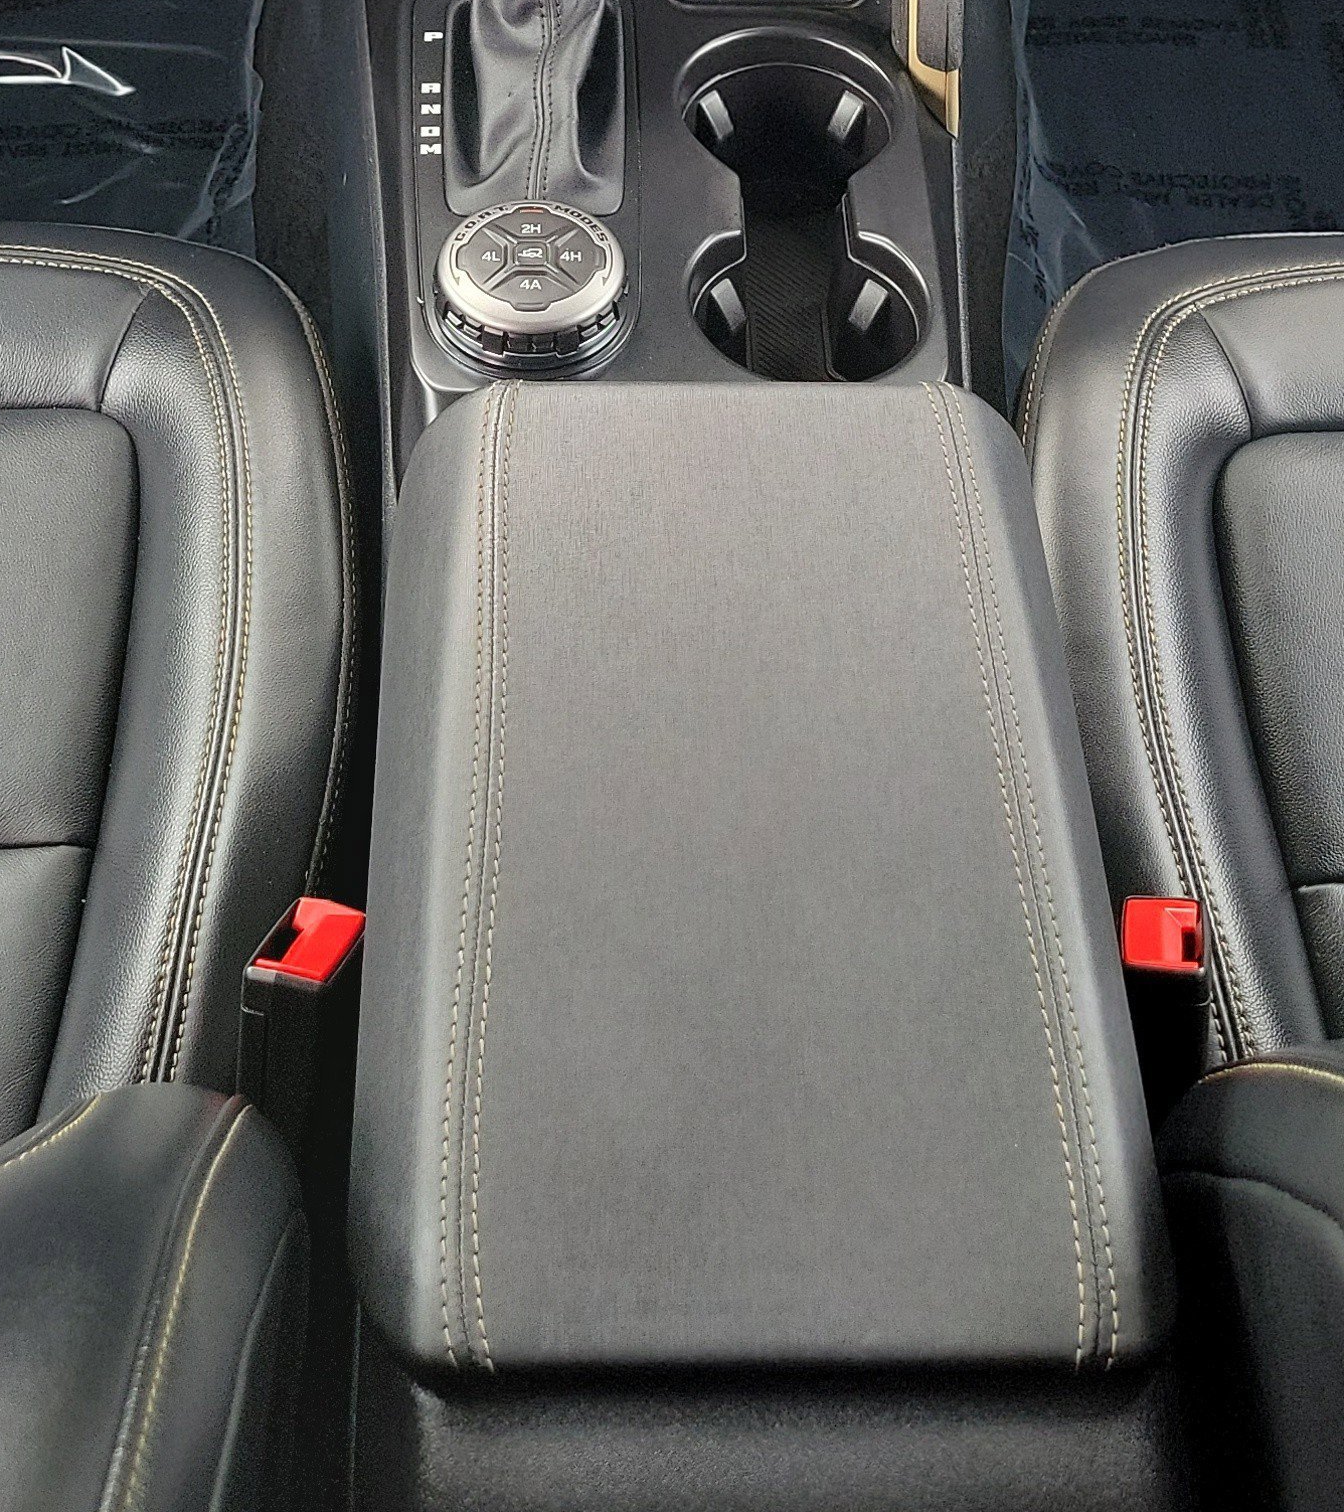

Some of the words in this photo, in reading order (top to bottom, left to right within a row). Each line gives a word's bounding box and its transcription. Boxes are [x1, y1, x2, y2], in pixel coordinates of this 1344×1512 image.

[424, 31, 443, 42] P
[421, 103, 441, 115] N
[419, 143, 442, 155] M
[521, 223, 542, 234] 2H
[554, 204, 610, 246] MODES
[481, 251, 501, 262] 4L
[559, 250, 582, 262] 4H
[520, 279, 542, 291] 4A
